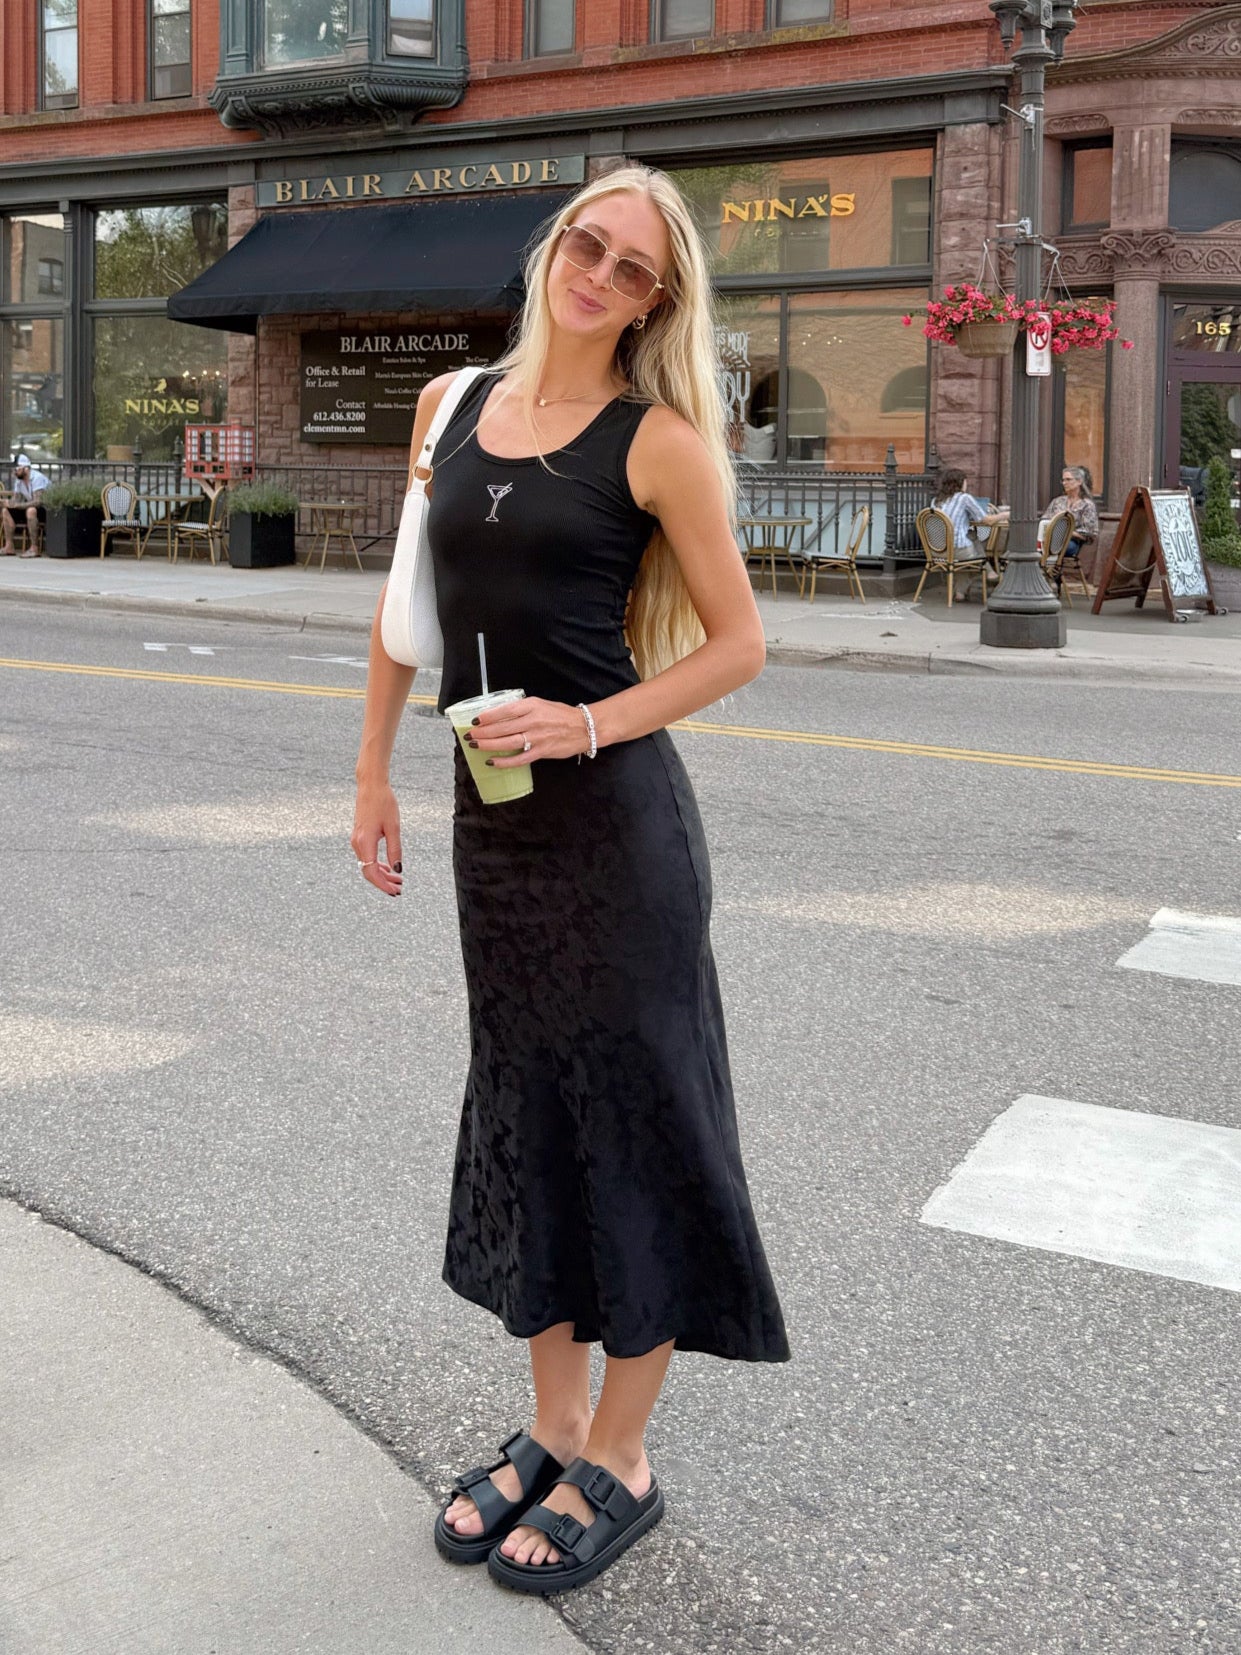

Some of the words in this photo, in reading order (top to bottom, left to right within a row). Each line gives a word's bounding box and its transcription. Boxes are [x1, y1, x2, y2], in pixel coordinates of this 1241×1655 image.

[274, 174, 384, 203] BLAIR
[405, 159, 560, 193] ARCADE
[722, 193, 856, 225] NINA'S
[1195, 321, 1232, 336] 165
[340, 336, 395, 353] BLAIR
[395, 334, 469, 352] ARCADE
[305, 366, 330, 377] Office
[331, 365, 340, 376] &
[341, 365, 366, 376] Retail
[305, 377, 316, 388] for
[317, 377, 339, 388] Lease
[125, 398, 200, 415] NINA'S
[335, 398, 366, 409] Contact
[313, 411, 366, 422] 612.436.8200
[303, 422, 366, 433] elementmn.com
